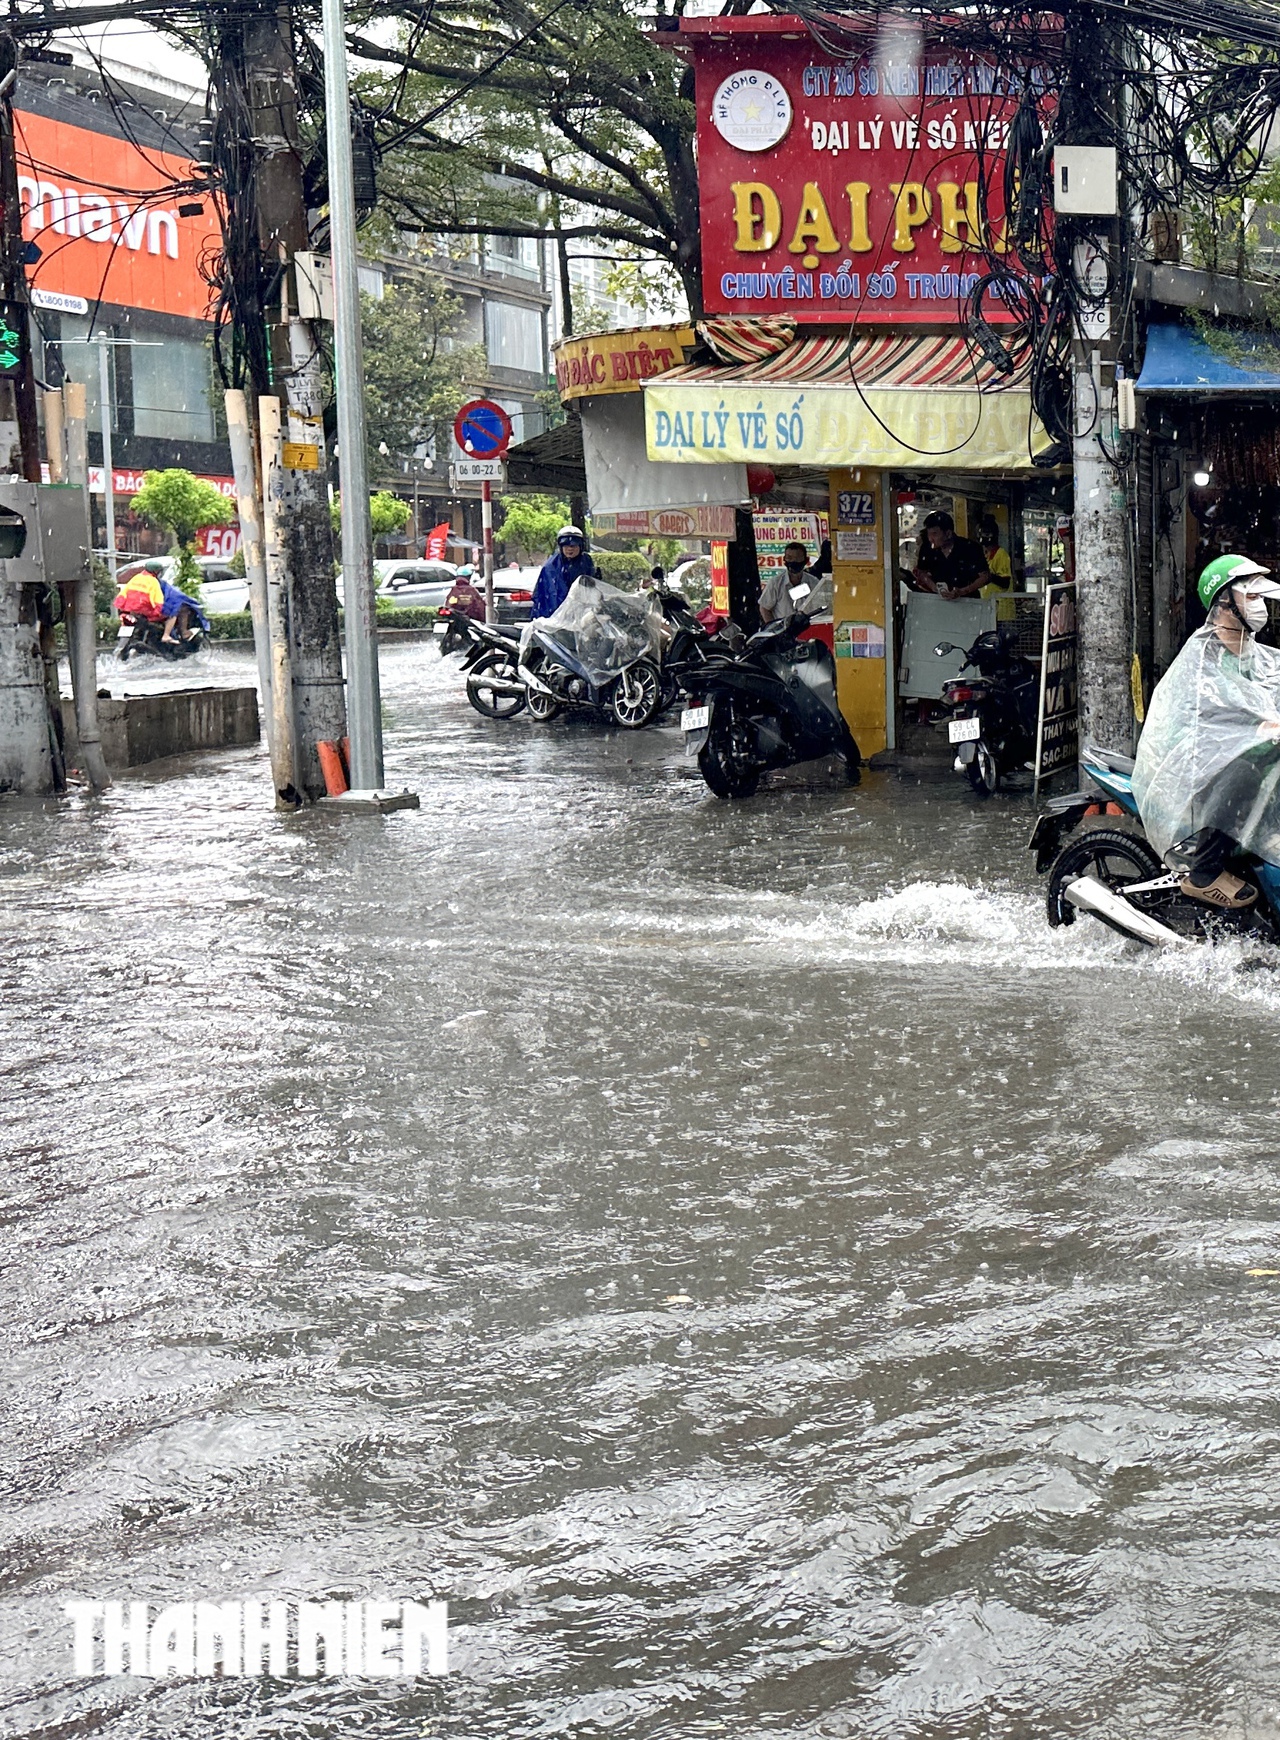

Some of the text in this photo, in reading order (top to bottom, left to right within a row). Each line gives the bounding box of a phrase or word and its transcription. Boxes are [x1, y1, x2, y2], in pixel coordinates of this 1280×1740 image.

[803, 66, 831, 96] CTY
[812, 122, 849, 155] ĐẠI
[858, 114, 884, 149] LÝ
[890, 114, 919, 149] VÉ
[927, 109, 957, 149] SỐ
[730, 181, 873, 269] ĐẠI
[720, 266, 813, 299] CHUYÊN
[818, 259, 860, 299] ĐỔI
[867, 260, 899, 299] SỐ
[570, 347, 606, 391] ĐẶC
[655, 411, 695, 457] ĐẠI
[701, 400, 730, 448] LÝ
[737, 401, 768, 449] VÉ
[776, 394, 804, 450] SỐ
[298, 453, 304, 461] 7
[840, 494, 872, 513] 372
[1203, 574, 1222, 596] Grab
